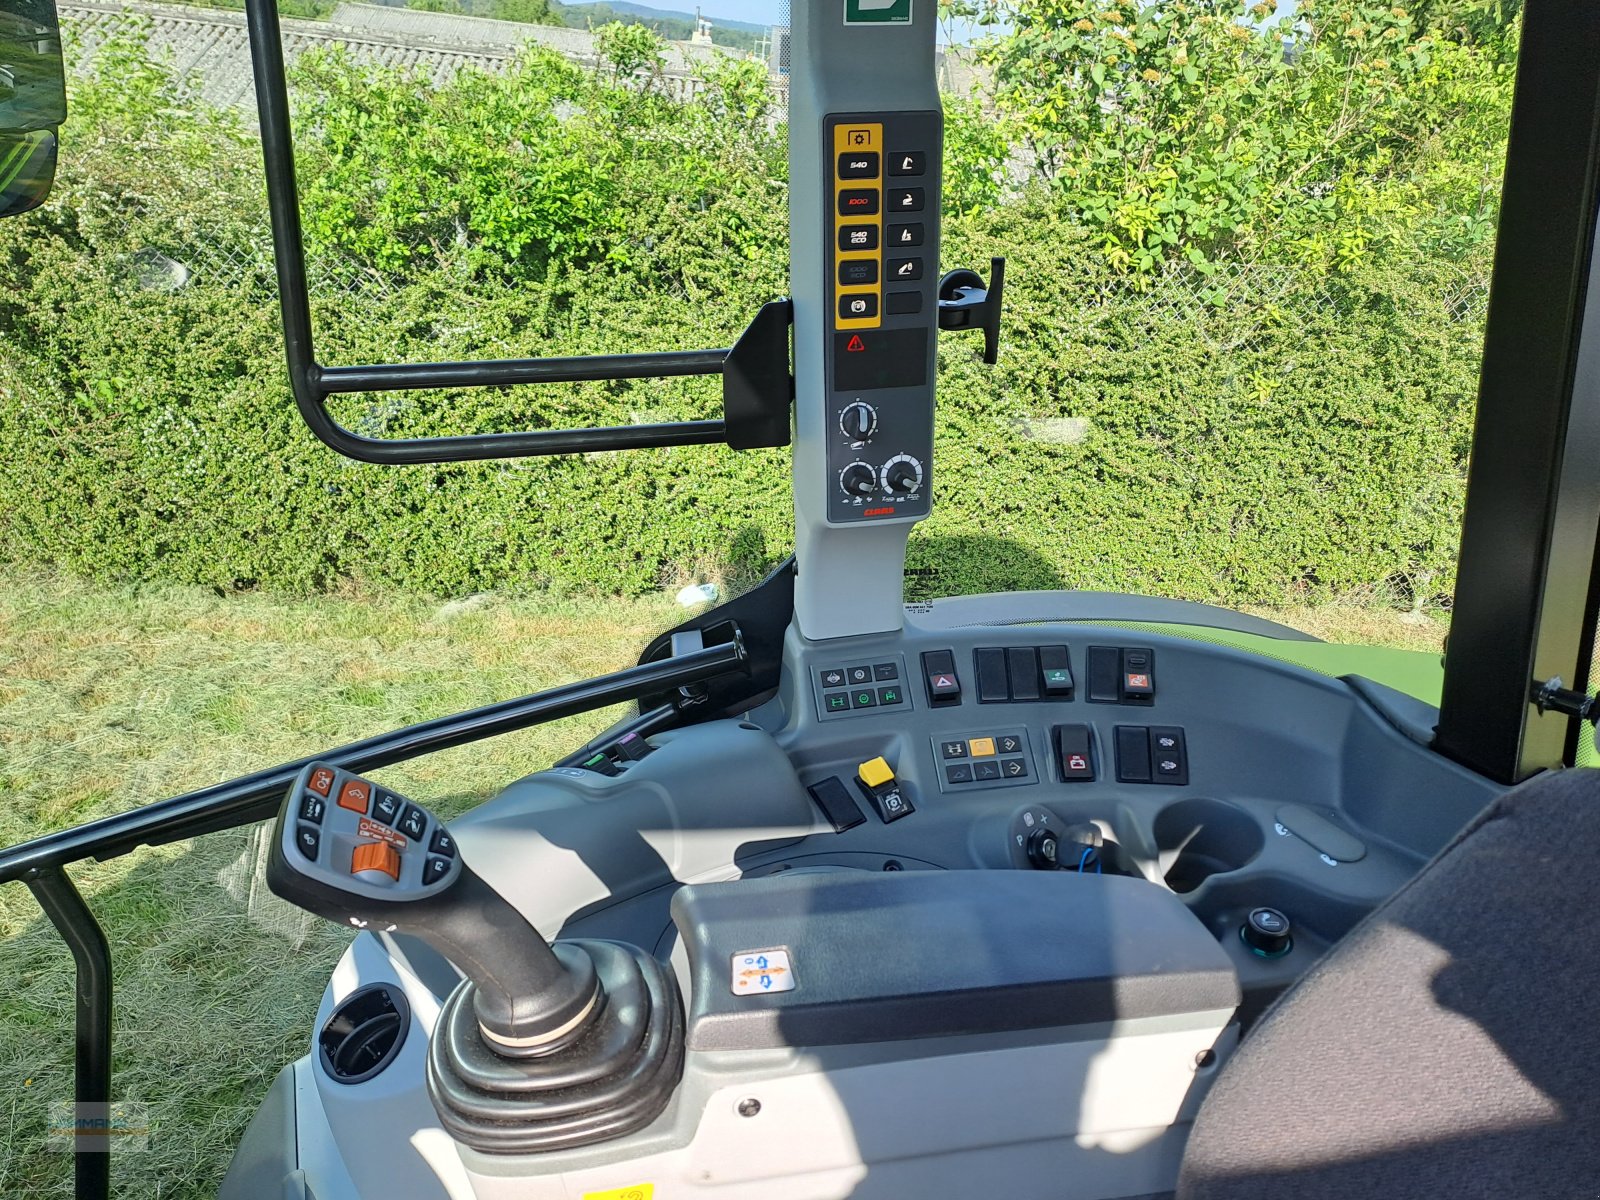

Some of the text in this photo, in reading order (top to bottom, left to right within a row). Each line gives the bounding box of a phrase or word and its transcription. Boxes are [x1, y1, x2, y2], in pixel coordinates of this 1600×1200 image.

[850, 161, 868, 169] 540
[848, 198, 869, 206] 1000
[411, 811, 421, 820] F2
[1016, 834, 1023, 847] P
[434, 861, 444, 871] F3
